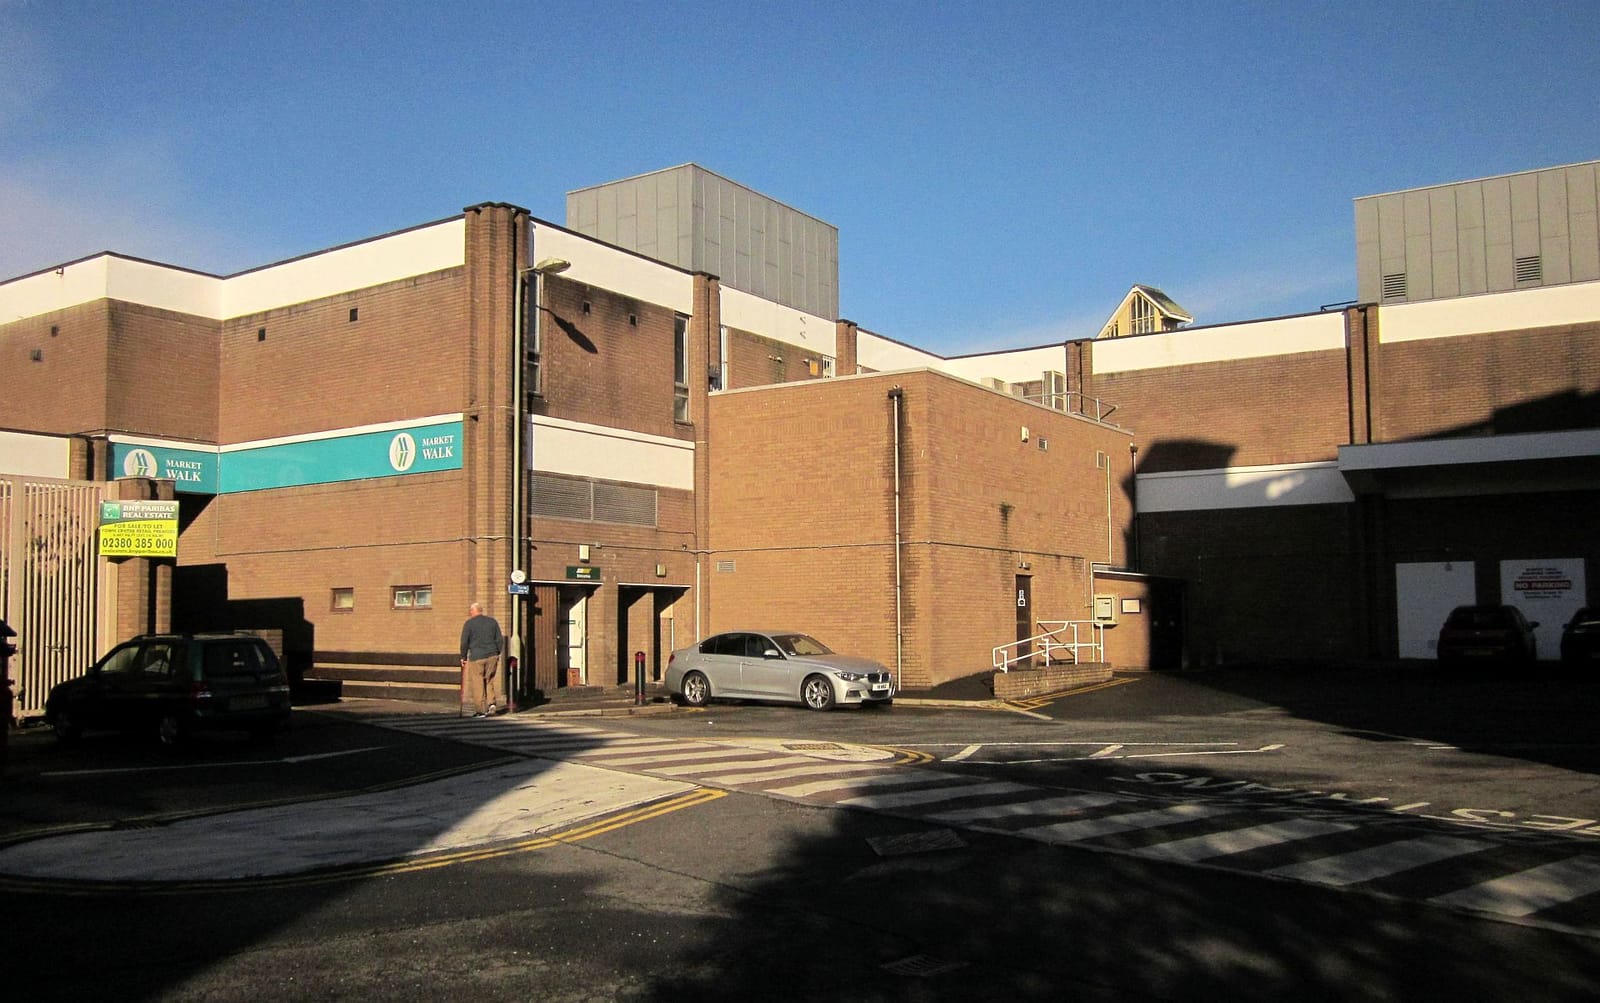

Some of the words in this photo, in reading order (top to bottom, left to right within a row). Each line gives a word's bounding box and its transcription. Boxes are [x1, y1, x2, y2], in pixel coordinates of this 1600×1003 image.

[422, 435, 454, 446] MARKET
[422, 446, 453, 460] WALK
[166, 459, 202, 470] MARKET
[166, 469, 201, 482] WALK
[102, 537, 132, 548] 02380
[135, 538, 153, 549] 385
[155, 538, 174, 549] 000
